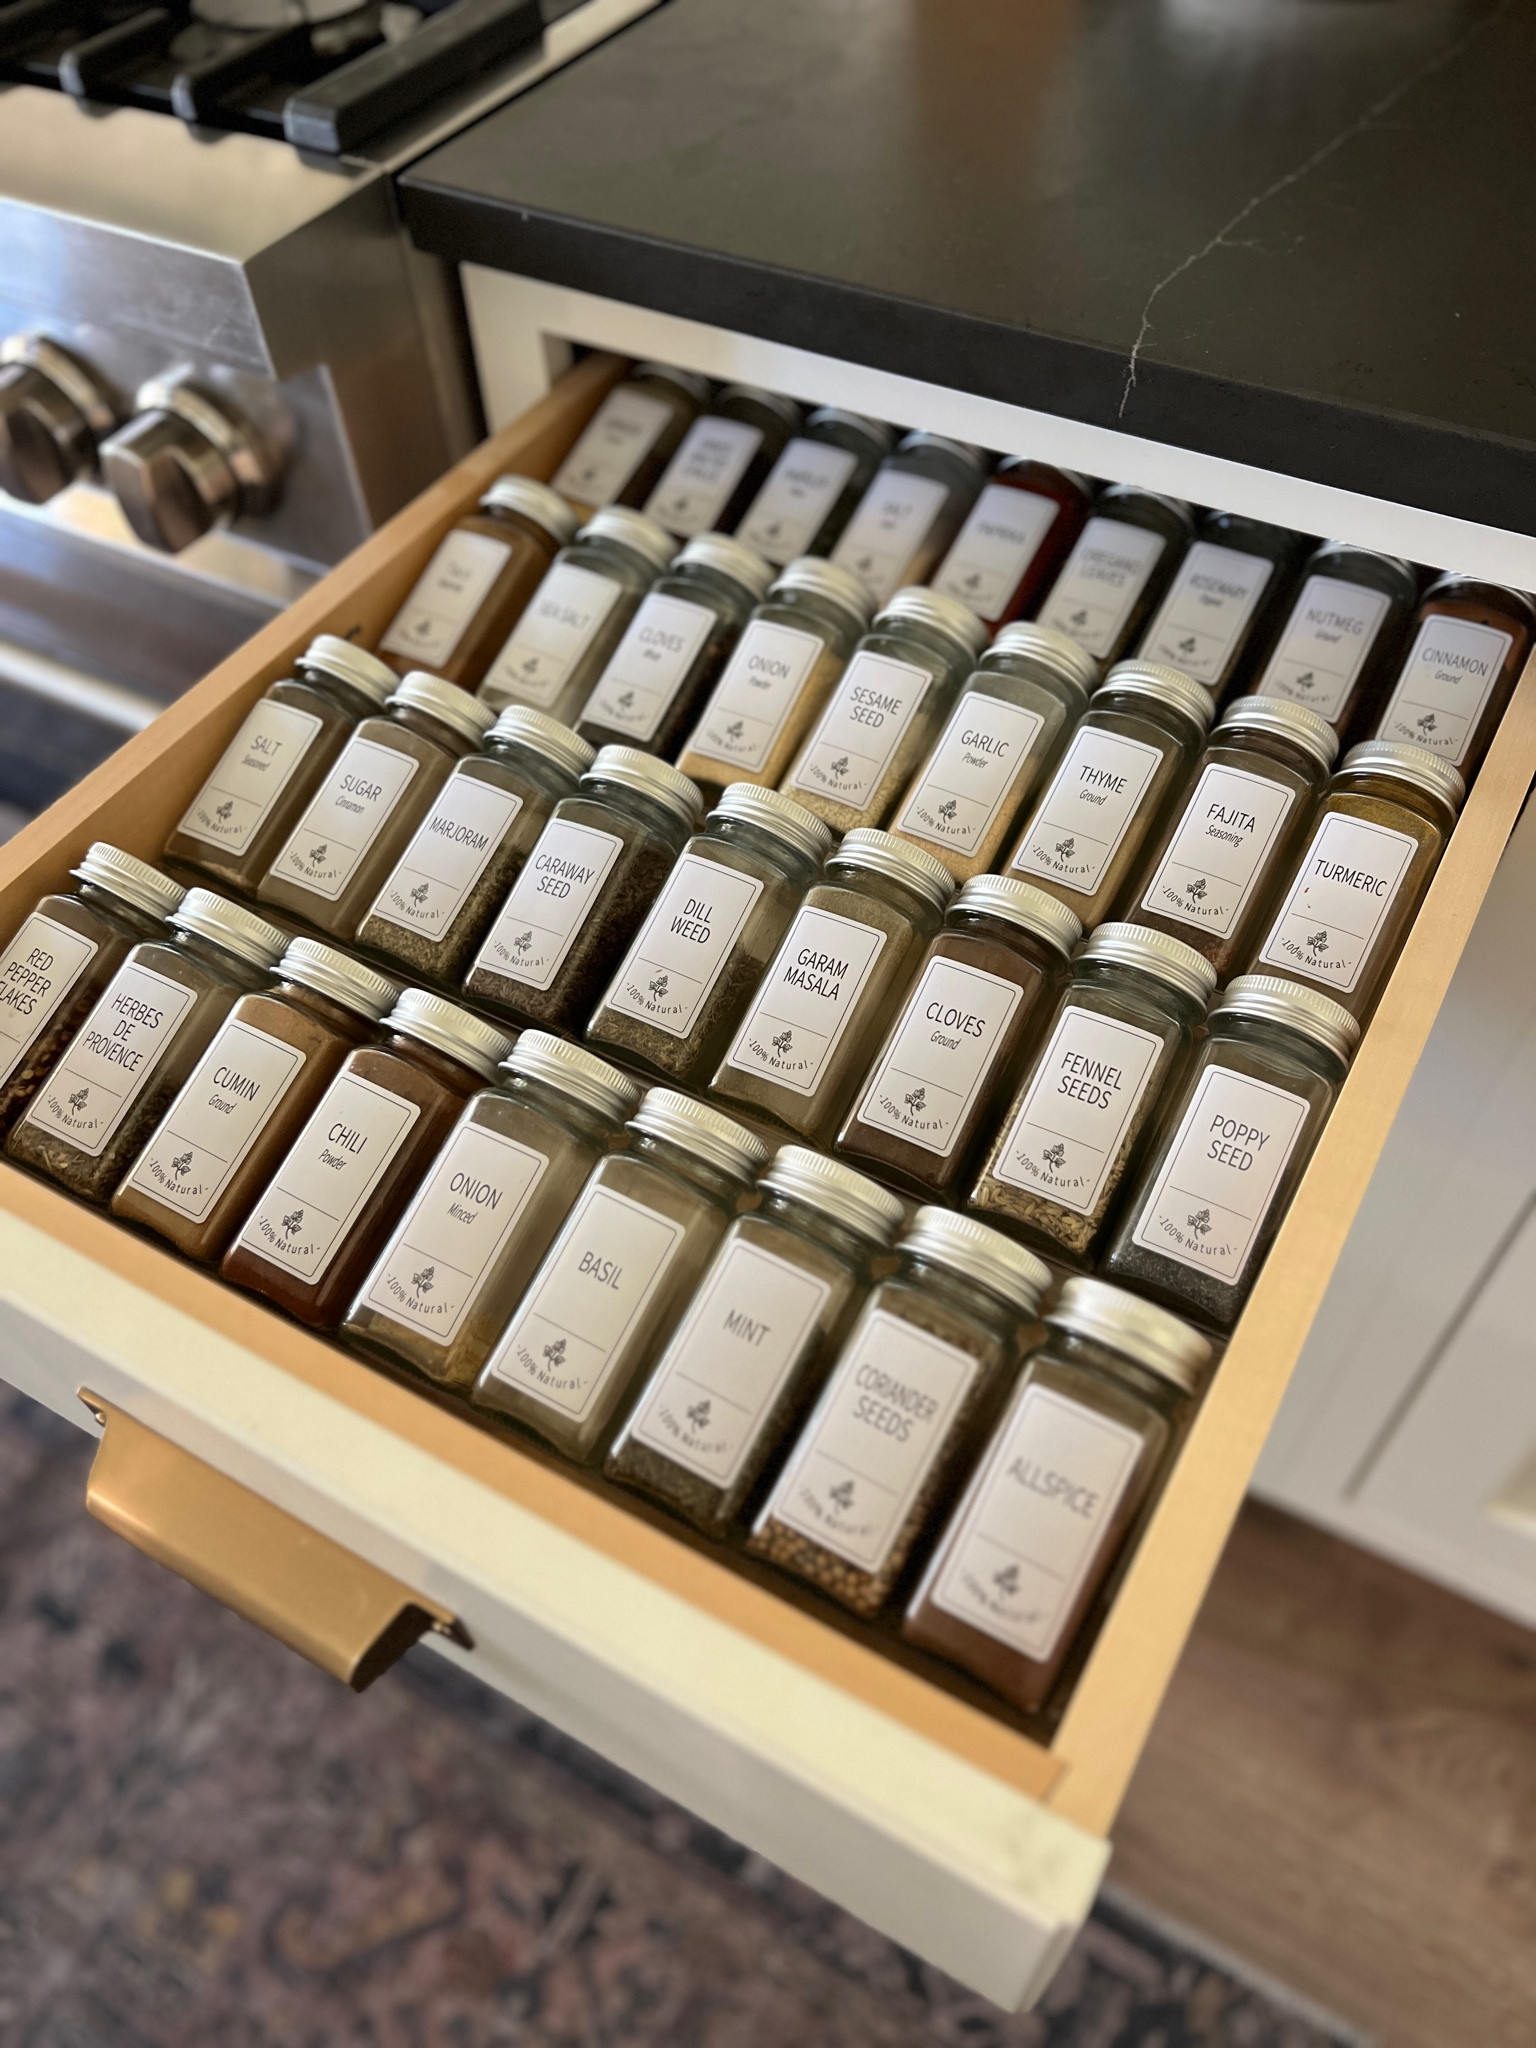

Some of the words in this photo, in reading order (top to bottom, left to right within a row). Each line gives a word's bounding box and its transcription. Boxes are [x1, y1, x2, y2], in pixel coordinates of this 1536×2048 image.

[1305, 608, 1365, 636] NUTMEG
[638, 626, 686, 649] CLOVES
[748, 655, 790, 678] ONION
[1422, 647, 1489, 677] CINNAMON
[1434, 670, 1462, 684] Ground
[851, 686, 902, 715] SESAME
[850, 706, 884, 728] SEED
[251, 735, 282, 756] SALT
[961, 730, 1010, 758] GARLIC
[241, 756, 270, 772] Seasoned
[962, 753, 989, 769] Powder
[340, 775, 382, 801] SUGAR
[1080, 765, 1127, 794] THYME
[336, 796, 365, 814] Cinnamon
[1080, 789, 1108, 805] Ground
[1207, 804, 1256, 833] FAJITA
[429, 817, 489, 852] MARJORAM
[1206, 825, 1243, 847] Seasoning
[535, 854, 595, 885] CARAWAY
[1314, 859, 1388, 897] TURMERIC
[537, 876, 571, 899] SEED
[683, 898, 713, 924] DILL
[670, 916, 711, 944] WEED
[26, 948, 53, 971] RED
[797, 948, 849, 979] GARAM
[4, 962, 51, 998] PEPPER
[783, 966, 840, 1000] MASALA
[111, 992, 164, 1029] HERBES
[926, 1002, 986, 1038] CLOVES
[113, 1020, 136, 1042] DE
[930, 1030, 962, 1050] Ground
[83, 1031, 143, 1072] PROVENCE
[213, 1066, 260, 1101] CUMIN
[1061, 1052, 1122, 1090] FENNEL
[208, 1094, 236, 1114] Ground
[1057, 1076, 1112, 1109] SEEDS
[328, 1123, 368, 1154] CHILI
[1210, 1115, 1270, 1151] POPPY
[319, 1149, 347, 1171] Powder
[1207, 1140, 1253, 1172] SEED
[450, 1172, 503, 1210] ONION
[447, 1203, 478, 1224] Minced
[578, 1251, 622, 1290] BASIL
[723, 1309, 771, 1347] MINT
[855, 1364, 938, 1422] CORIANDER
[853, 1396, 914, 1442] SEEDS
[1008, 1457, 1098, 1519] ALLSPICE
